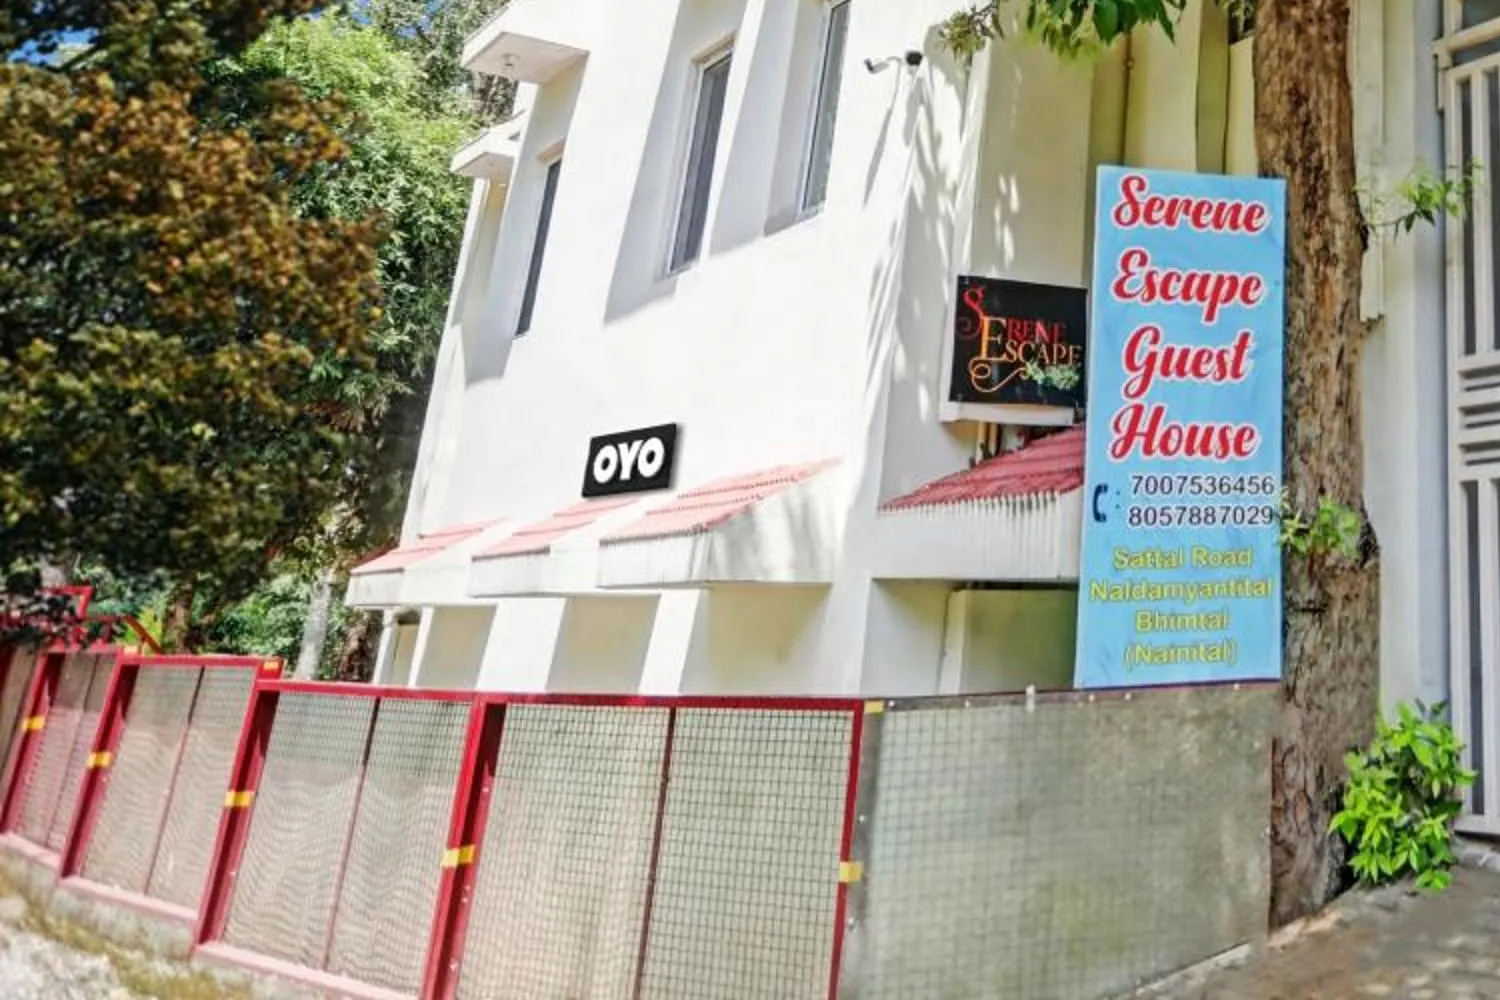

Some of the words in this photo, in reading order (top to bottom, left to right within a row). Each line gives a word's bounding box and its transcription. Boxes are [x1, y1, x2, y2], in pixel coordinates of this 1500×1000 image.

[1114, 175, 1266, 233] Serene
[1113, 248, 1262, 322] Escape
[1123, 325, 1252, 398] Guest
[1111, 403, 1256, 459] House
[593, 436, 665, 484] OYO
[1131, 475, 1275, 496] 7007536456
[1128, 505, 1274, 527] 8057887029
[1114, 547, 1184, 570] Sattal
[1191, 545, 1254, 568] Road
